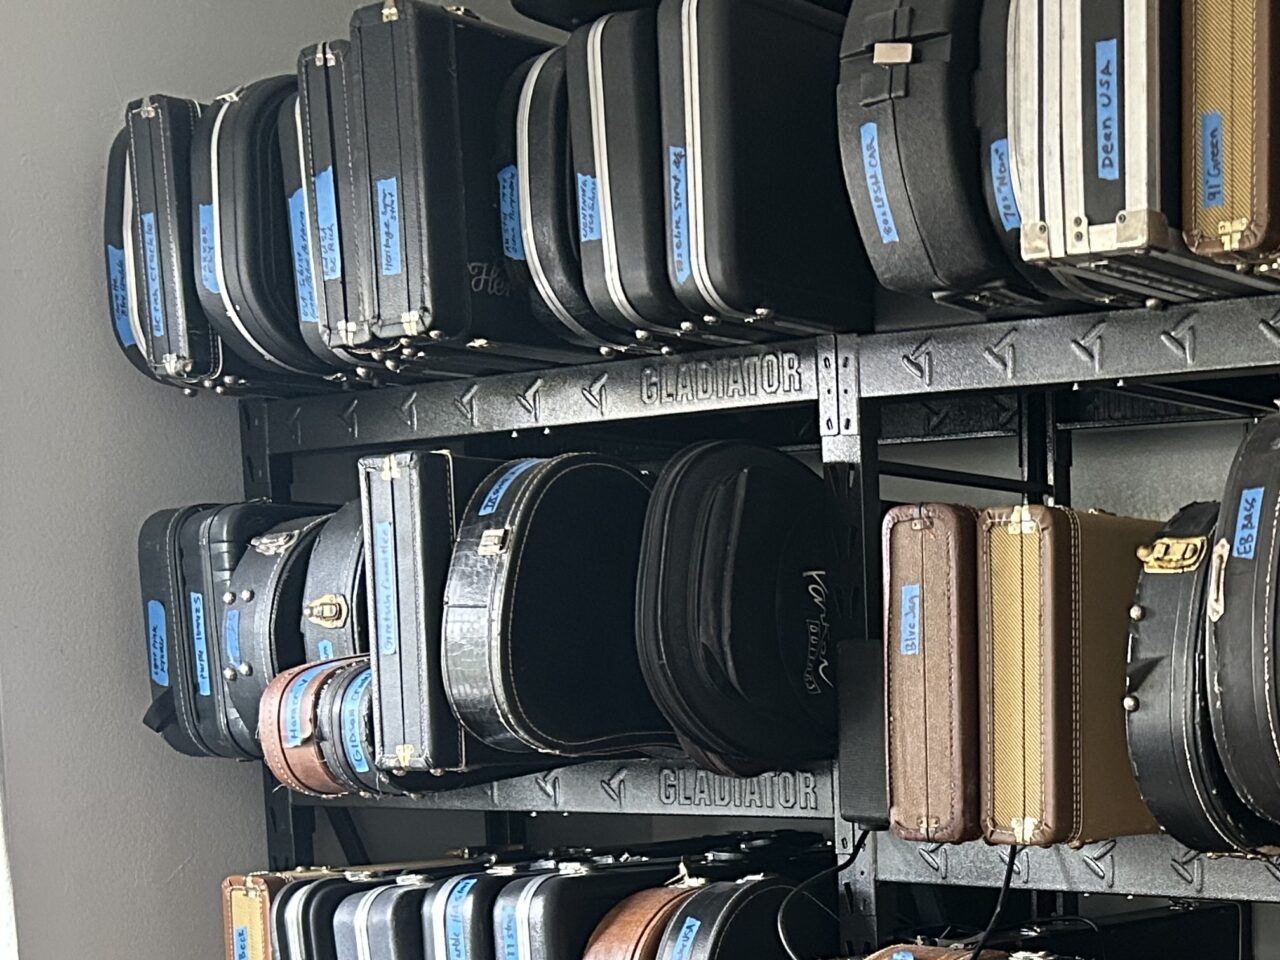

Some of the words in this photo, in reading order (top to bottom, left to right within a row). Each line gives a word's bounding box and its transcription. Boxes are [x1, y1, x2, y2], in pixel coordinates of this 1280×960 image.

[1099, 59, 1112, 108] USA
[1101, 116, 1114, 170] Dean
[1206, 127, 1221, 178] Green
[640, 351, 803, 405] GLADIATOR
[658, 767, 818, 810] GLADIATOR
